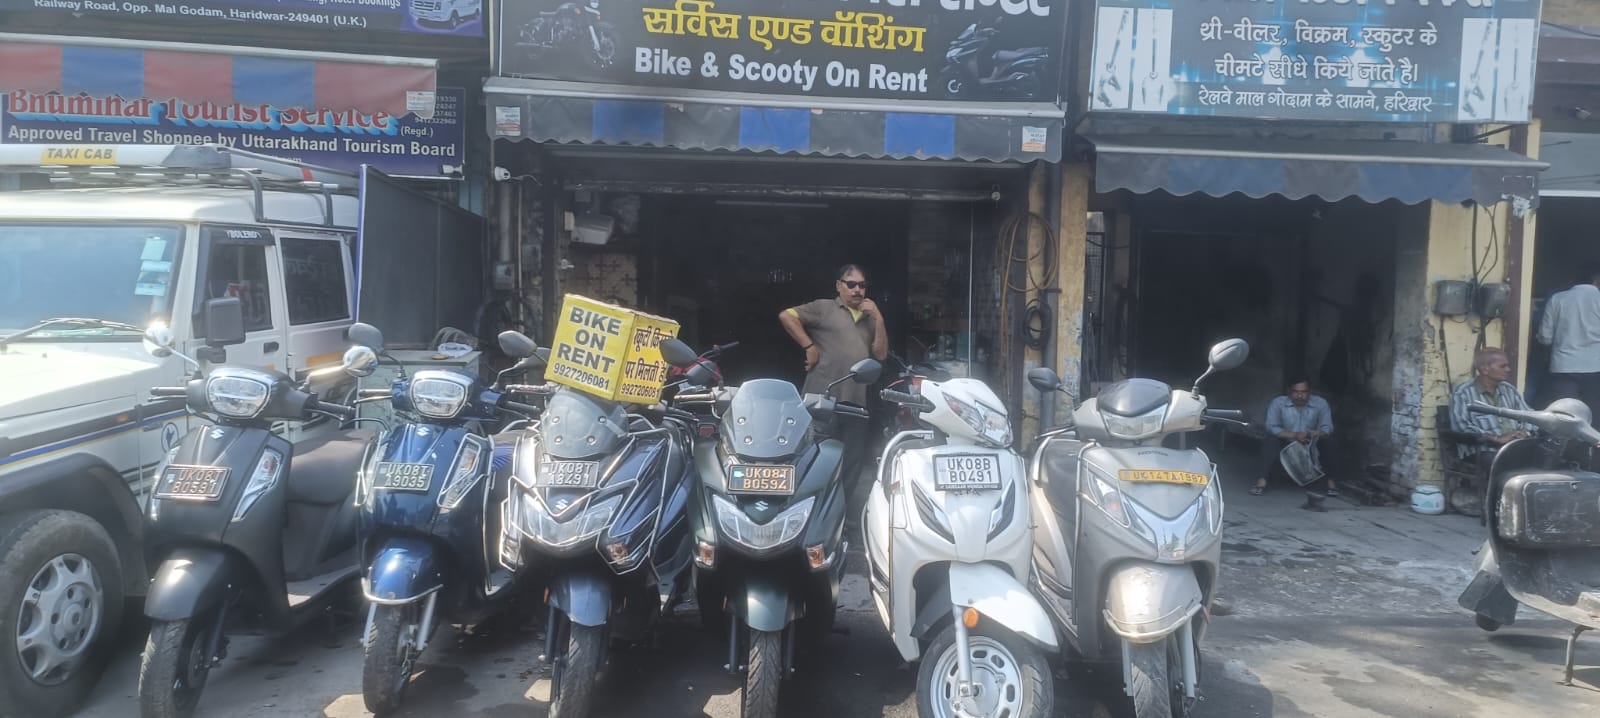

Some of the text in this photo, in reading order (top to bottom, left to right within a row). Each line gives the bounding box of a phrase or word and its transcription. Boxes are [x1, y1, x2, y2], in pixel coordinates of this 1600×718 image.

[34, 0, 367, 28] Railway Road, Opp. Mal Godam, Haridwar-249401 (U.K.)
[642, 0, 927, 52] सर्विस एण्ड वॉशिंग
[1295, 20, 1356, 48] विक्रम,
[1419, 21, 1438, 45] के
[635, 46, 928, 92] Bike & Scooty On Rent
[1214, 52, 1264, 77] चीमटे
[1268, 55, 1308, 79] सीधे
[1313, 55, 1353, 80] किये
[1359, 57, 1395, 82] जाते
[167, 98, 272, 124] Tourist
[1198, 85, 1233, 105] रेलवे
[1235, 90, 1264, 106] माल
[1268, 87, 1312, 108] गोदाम
[1315, 88, 1331, 107] के
[1383, 90, 1433, 113] हरिद्वार
[8, 125, 456, 156] Approved Travel Shoppee by Uttarakhand Tourism Board
[400, 126, 434, 138] (Regd.)
[47, 148, 113, 159] TAXI CAB
[569, 306, 622, 336] BIKE
[575, 329, 607, 352] ON
[557, 342, 616, 373] RENT
[553, 362, 610, 391] 9927206081
[620, 383, 660, 398] 9927206081
[178, 469, 224, 481] UK08T
[387, 463, 429, 476] UK08T
[551, 462, 593, 474] UK08T
[745, 467, 789, 479] UK08T
[947, 458, 991, 470] UK08B
[949, 470, 992, 482] B0491
[743, 478, 787, 490] B0594
